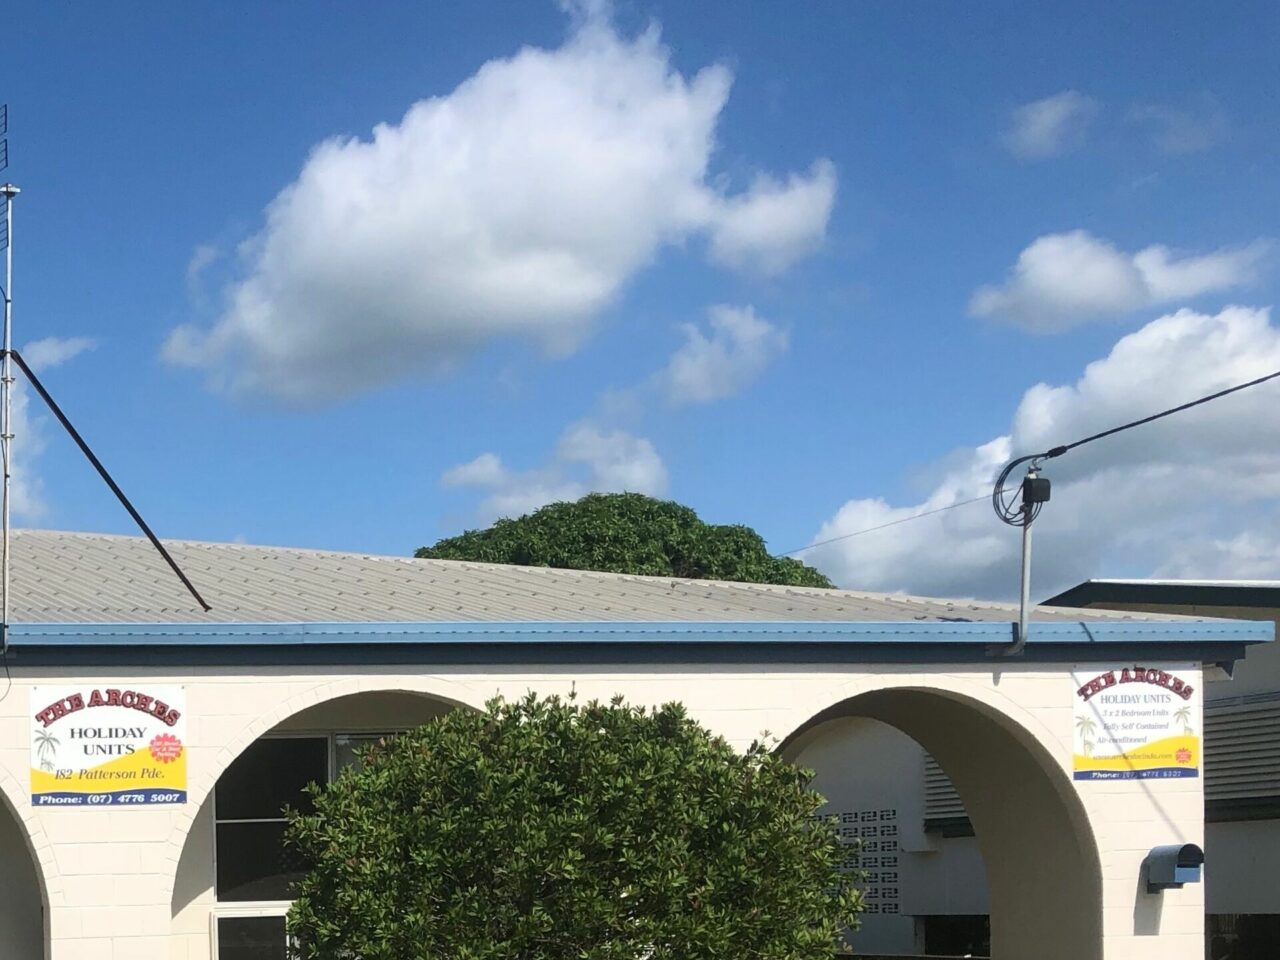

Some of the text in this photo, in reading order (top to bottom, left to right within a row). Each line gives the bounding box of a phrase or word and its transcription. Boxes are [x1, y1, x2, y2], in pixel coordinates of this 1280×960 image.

[1076, 667, 1194, 702] THE ARCHES
[1100, 694, 1171, 704] HOLIDAY UNITS
[35, 689, 181, 728] THE ARCHES
[1136, 722, 1169, 730] Contained
[70, 727, 147, 740] HOLIDAY
[83, 744, 135, 756] UNITS
[55, 768, 165, 780] 182 Patterson Pde.
[39, 793, 180, 804] Phone: (07) 4776 5007
